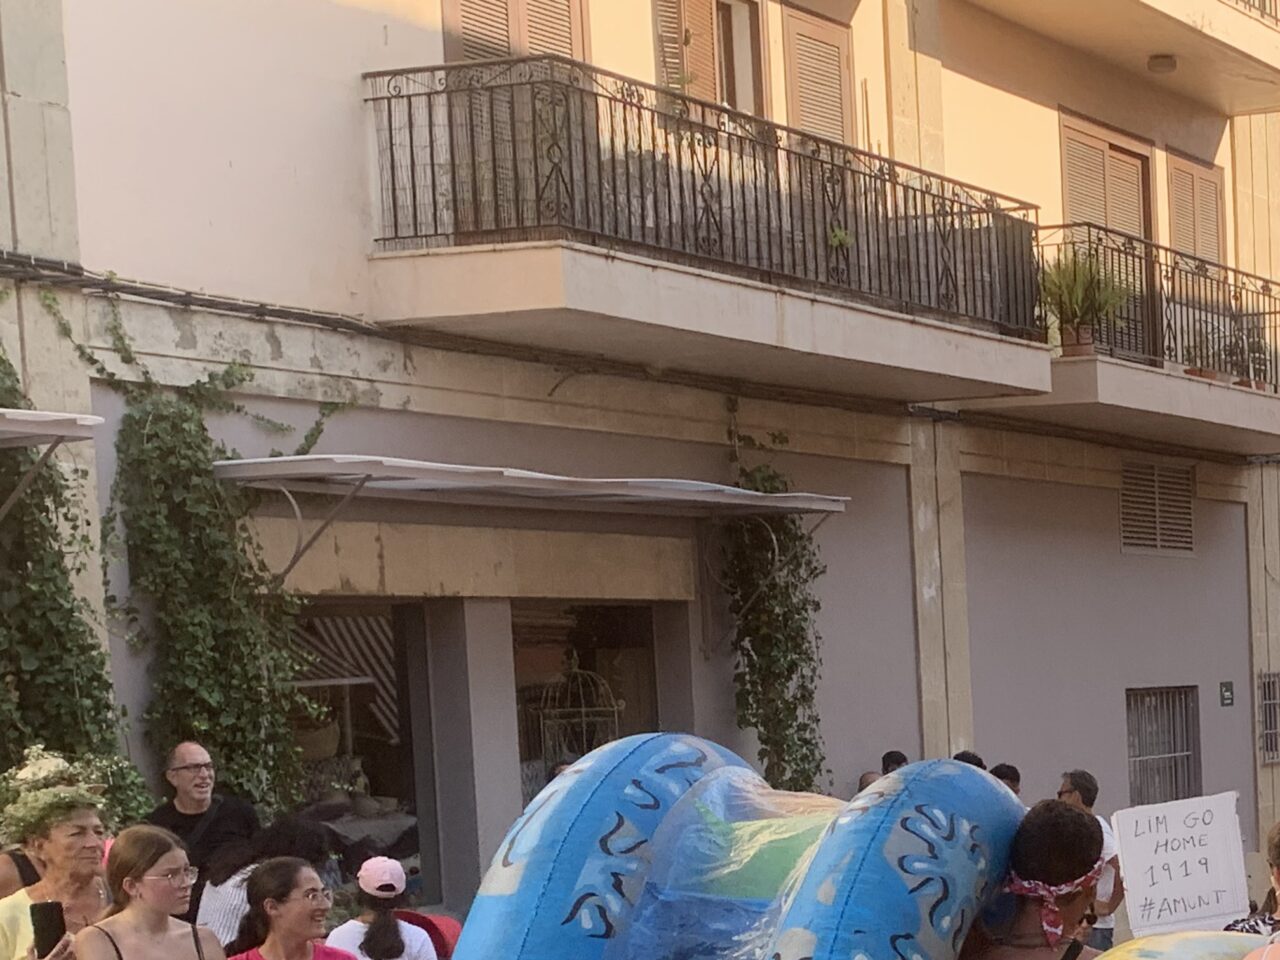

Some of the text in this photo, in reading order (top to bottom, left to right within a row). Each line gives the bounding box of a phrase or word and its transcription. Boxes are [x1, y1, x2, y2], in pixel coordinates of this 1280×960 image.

[1134, 809, 1214, 838] LIM GO
[1154, 834, 1209, 855] HOME
[1144, 856, 1209, 887] 1919
[1139, 890, 1227, 920] #AMUNT
